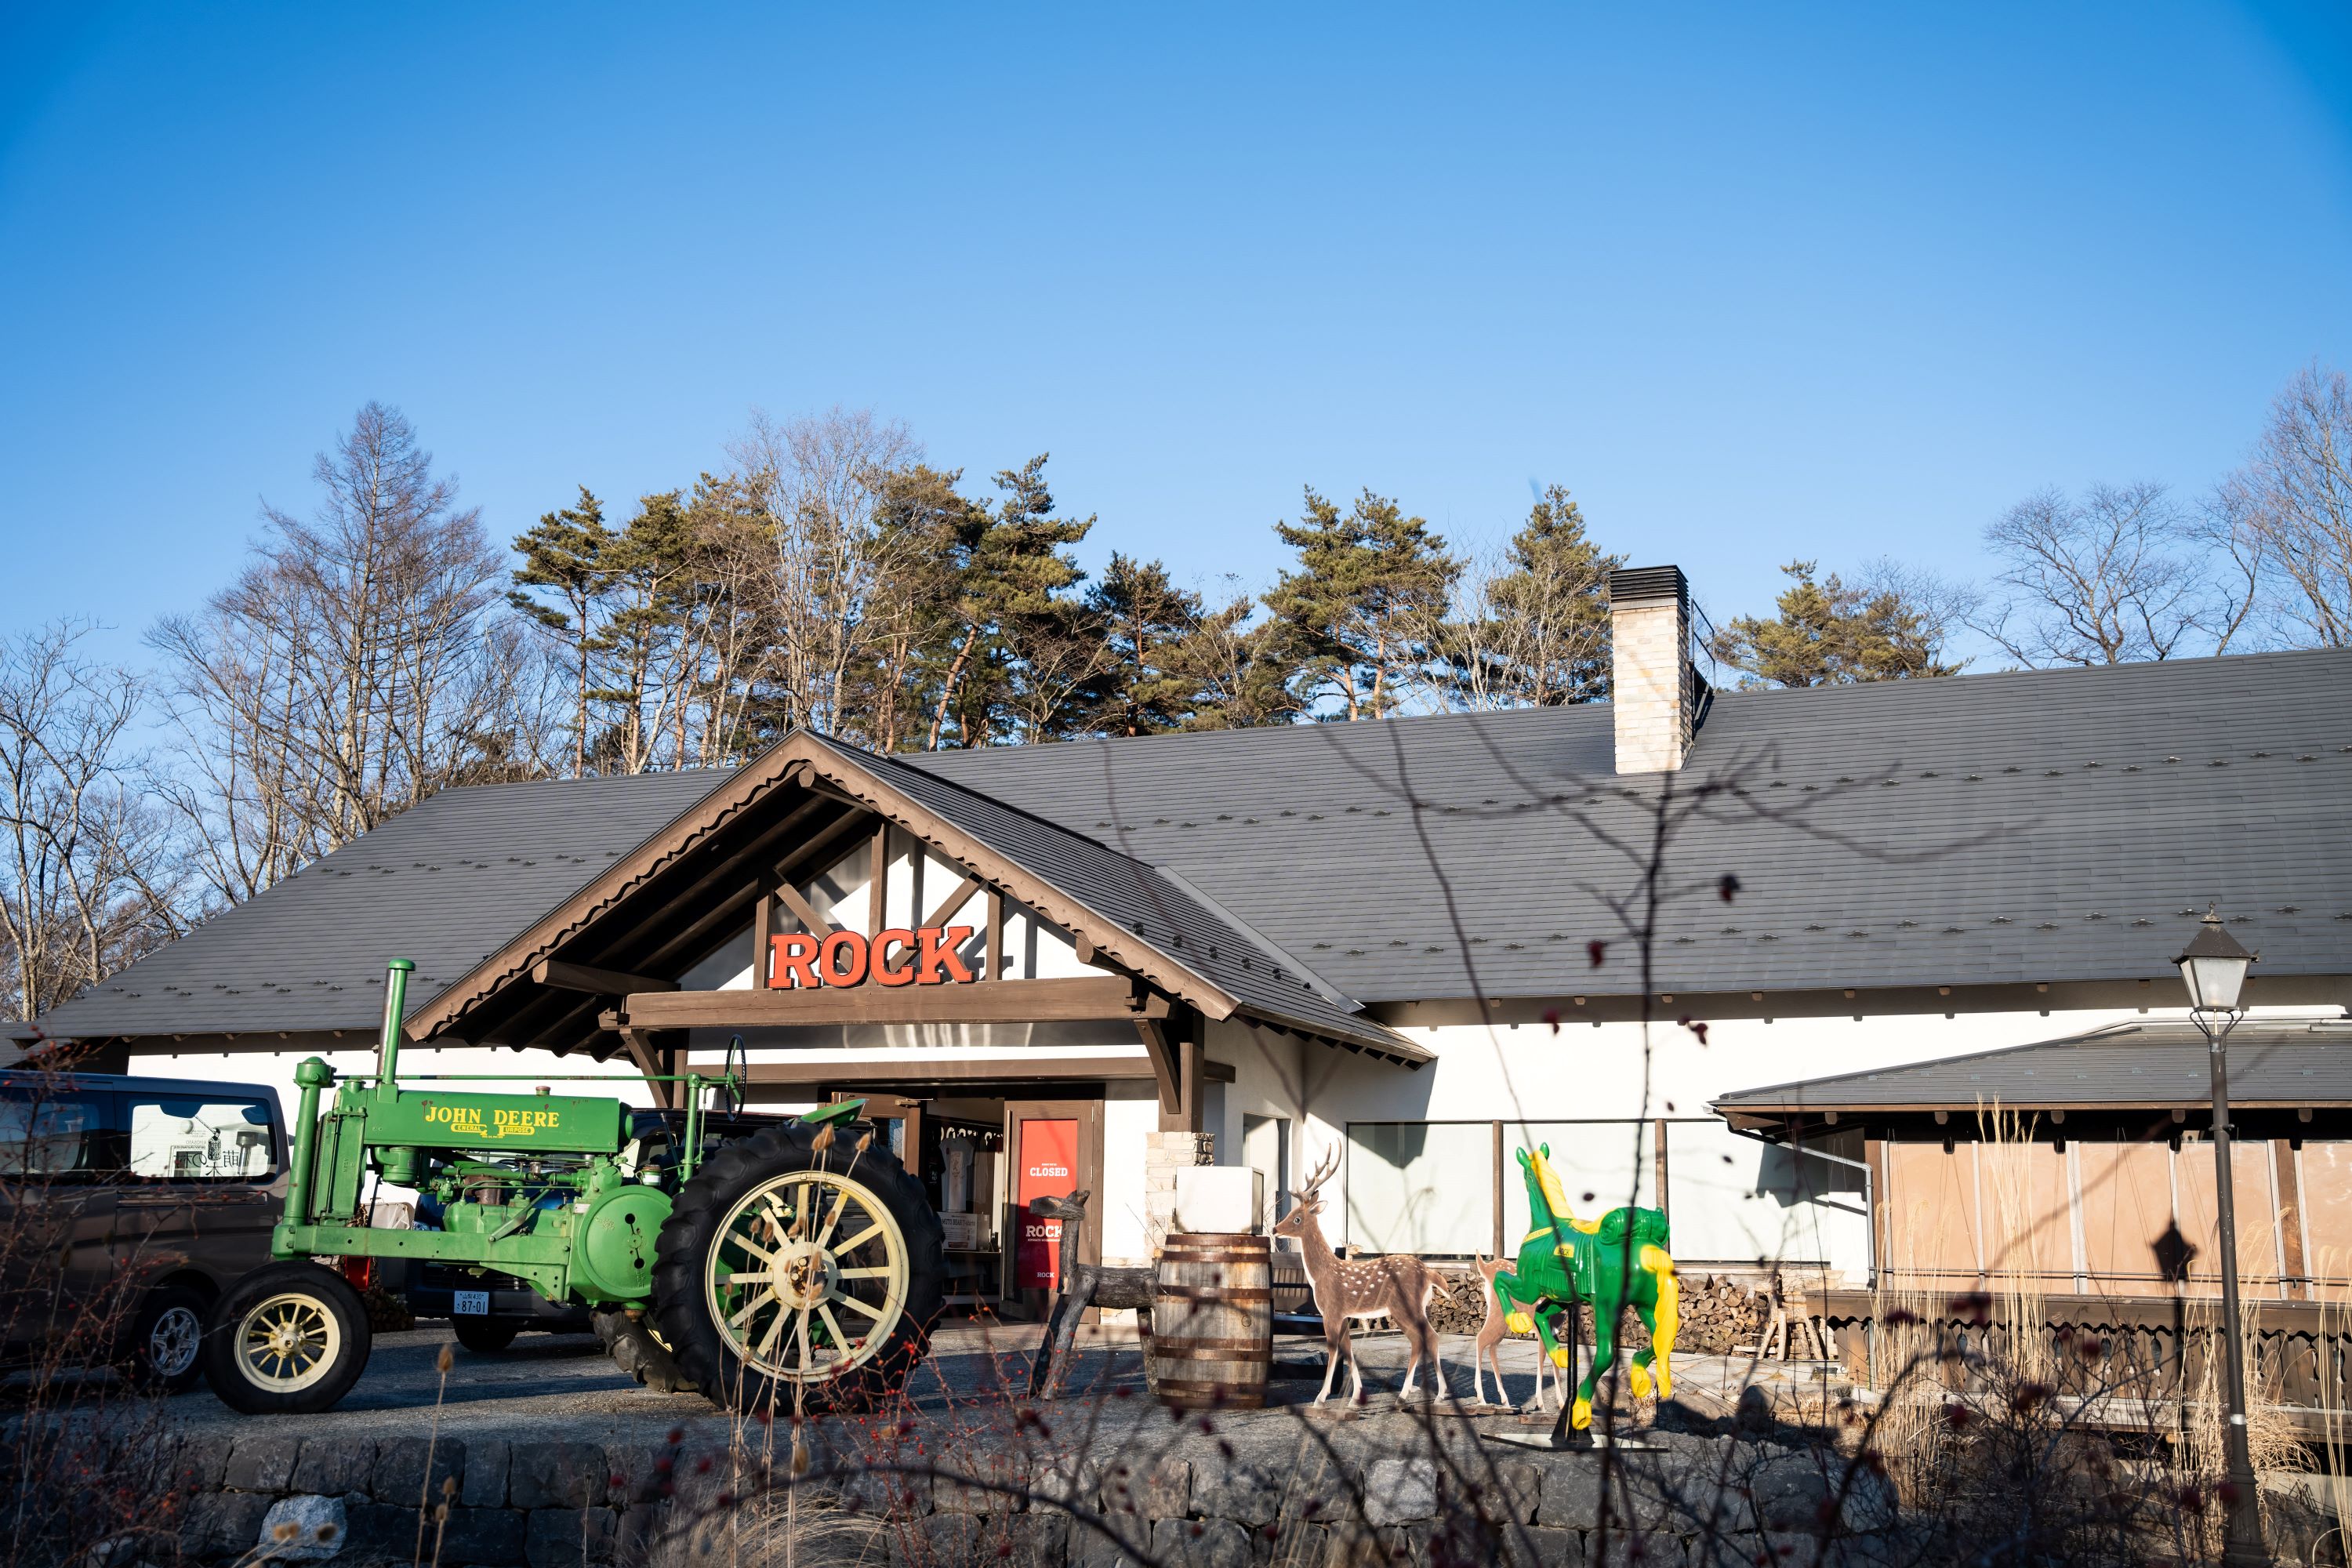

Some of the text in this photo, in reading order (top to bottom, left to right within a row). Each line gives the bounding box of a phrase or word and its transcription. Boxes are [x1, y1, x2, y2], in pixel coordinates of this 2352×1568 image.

[768, 926, 975, 989] ROCK
[425, 1106, 560, 1127] JOHN DEERE
[1029, 1167, 1068, 1177] CLOSED
